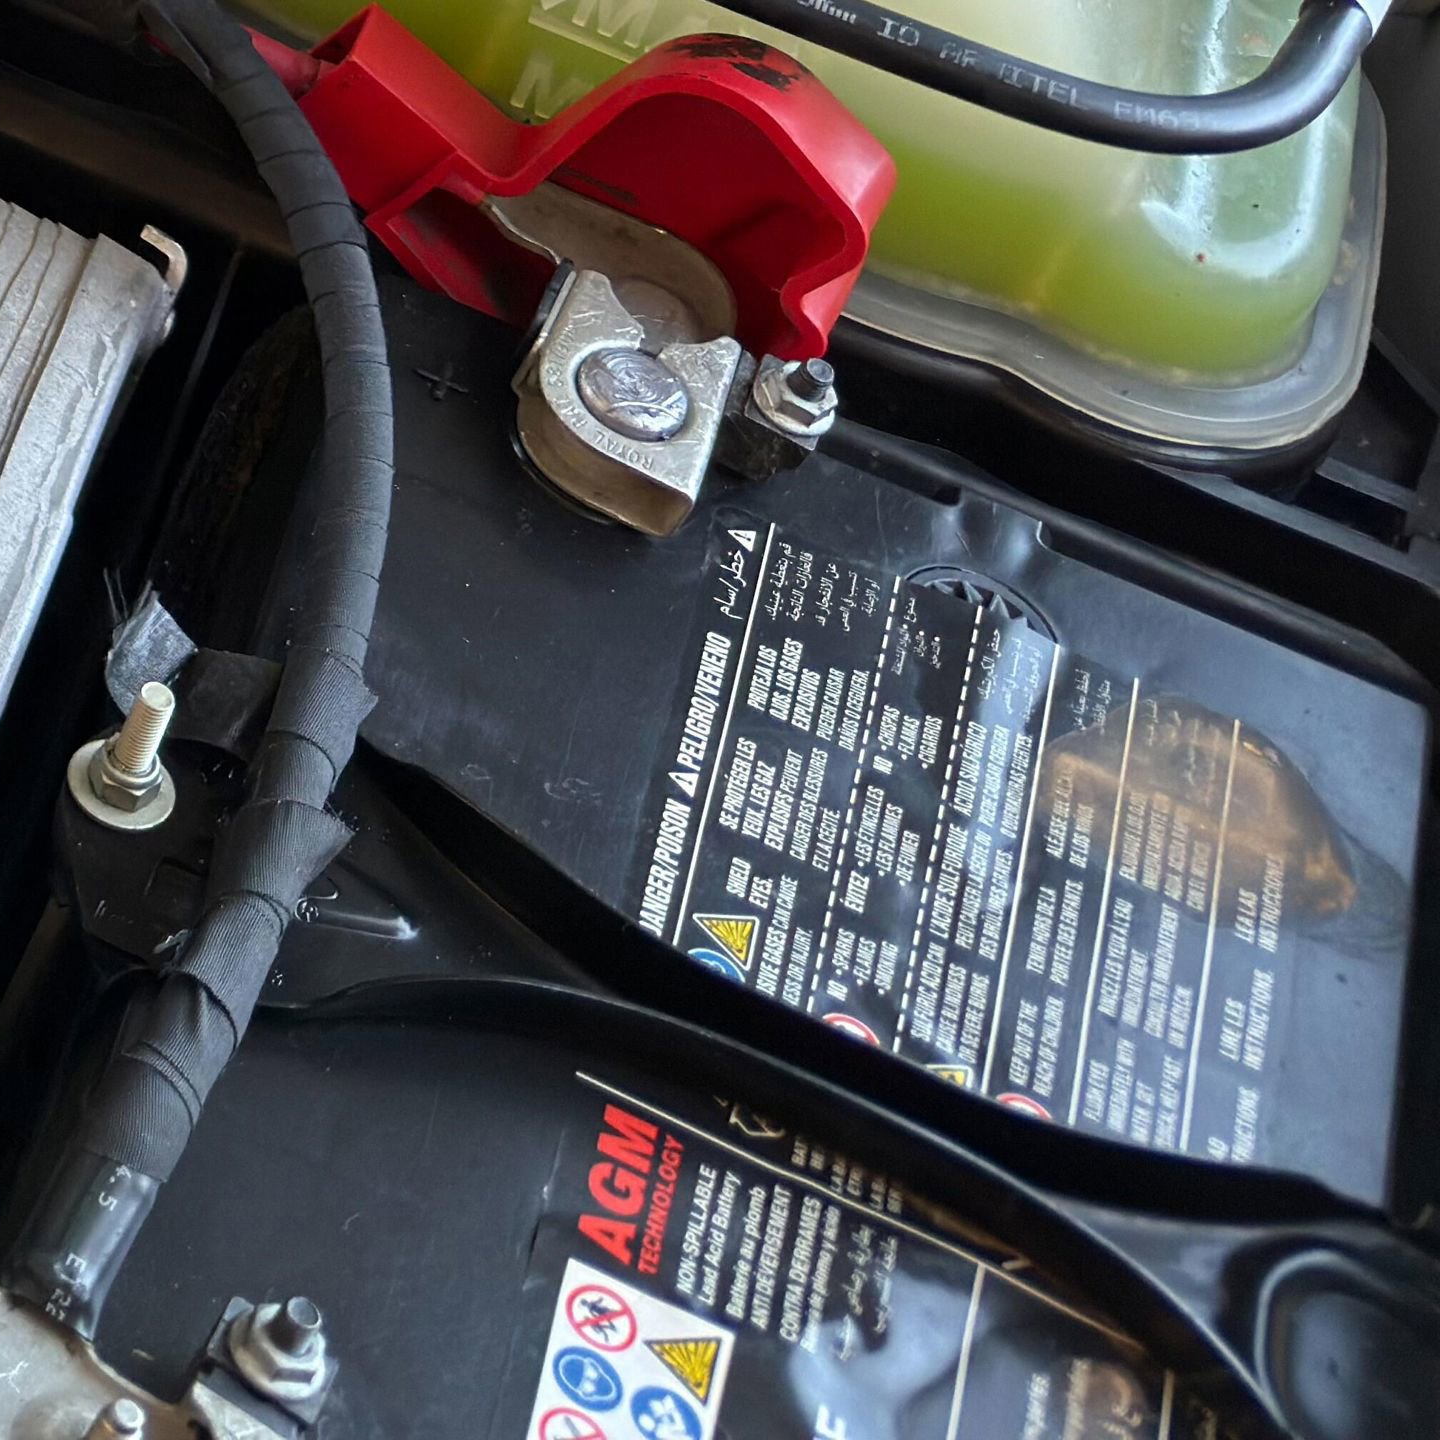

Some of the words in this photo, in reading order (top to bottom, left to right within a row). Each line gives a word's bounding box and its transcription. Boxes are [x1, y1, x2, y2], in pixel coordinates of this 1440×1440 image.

[756, 644, 777, 668] LOS
[779, 637, 803, 672] GASES
[746, 664, 773, 711] PROTEJA
[775, 668, 796, 692] LOS
[790, 668, 820, 731] EXPLOSIVOS
[823, 667, 845, 705] CAUSAR
[676, 631, 731, 771] PELIGRO/VENENO
[768, 690, 792, 720] OJOS.
[815, 702, 837, 741] PUEDEN
[877, 704, 900, 746] CHISPAS
[897, 715, 920, 755] FLAMAS
[917, 714, 942, 763] CIGARROS
[735, 736, 757, 761] LES
[872, 755, 892, 774] NO
[958, 720, 989, 784] SULFÚRICO
[722, 756, 752, 815] PROTÉGER
[753, 760, 776, 786] GAZ
[802, 747, 828, 803] BLESSURES
[748, 782, 771, 807] LES
[763, 789, 794, 851] EXPLOSIFS
[779, 748, 802, 794] PEUVENT
[797, 800, 816, 823] DES
[853, 785, 884, 843] ÉTINCELLES
[948, 779, 978, 817] ÁCIDO
[718, 810, 739, 829] SE
[741, 806, 766, 838] YEUX.
[877, 803, 903, 853] FLAMMES
[789, 819, 812, 860] CAUSER
[815, 842, 832, 858] LA
[854, 840, 873, 862] LES
[897, 830, 919, 867] FUMER
[725, 857, 751, 897] SHIELD
[811, 854, 829, 871] ET
[874, 849, 893, 871] LES
[895, 863, 913, 882] DE
[936, 823, 970, 897] SULFURIQUE
[748, 876, 773, 909] EYES.
[776, 874, 797, 909] CAUSE
[839, 870, 869, 913] ÉVITEZ
[771, 906, 790, 930] CAN
[762, 926, 787, 965] GASES
[831, 927, 855, 970] SPARKS
[852, 936, 876, 980] FLAMES
[873, 940, 898, 990] SMOKING
[926, 941, 945, 964] CAN
[786, 963, 805, 981] OR
[826, 979, 847, 1001] NO
[919, 960, 942, 990] ACID
[910, 985, 937, 1042] SULFURIC
[578, 1105, 657, 1264] AGM
[637, 1135, 682, 1273] TECHNOLOGY
[712, 1171, 741, 1230] Battery
[676, 1164, 716, 1294] NON-SPILLABLE
[743, 1186, 765, 1239] plomb
[704, 1228, 725, 1267] Acid
[740, 1237, 755, 1259] au
[788, 1196, 820, 1283] DERRAMES
[696, 1265, 718, 1305] Lead
[725, 1260, 751, 1318] Batterie
[779, 1283, 804, 1343] CONTRA
